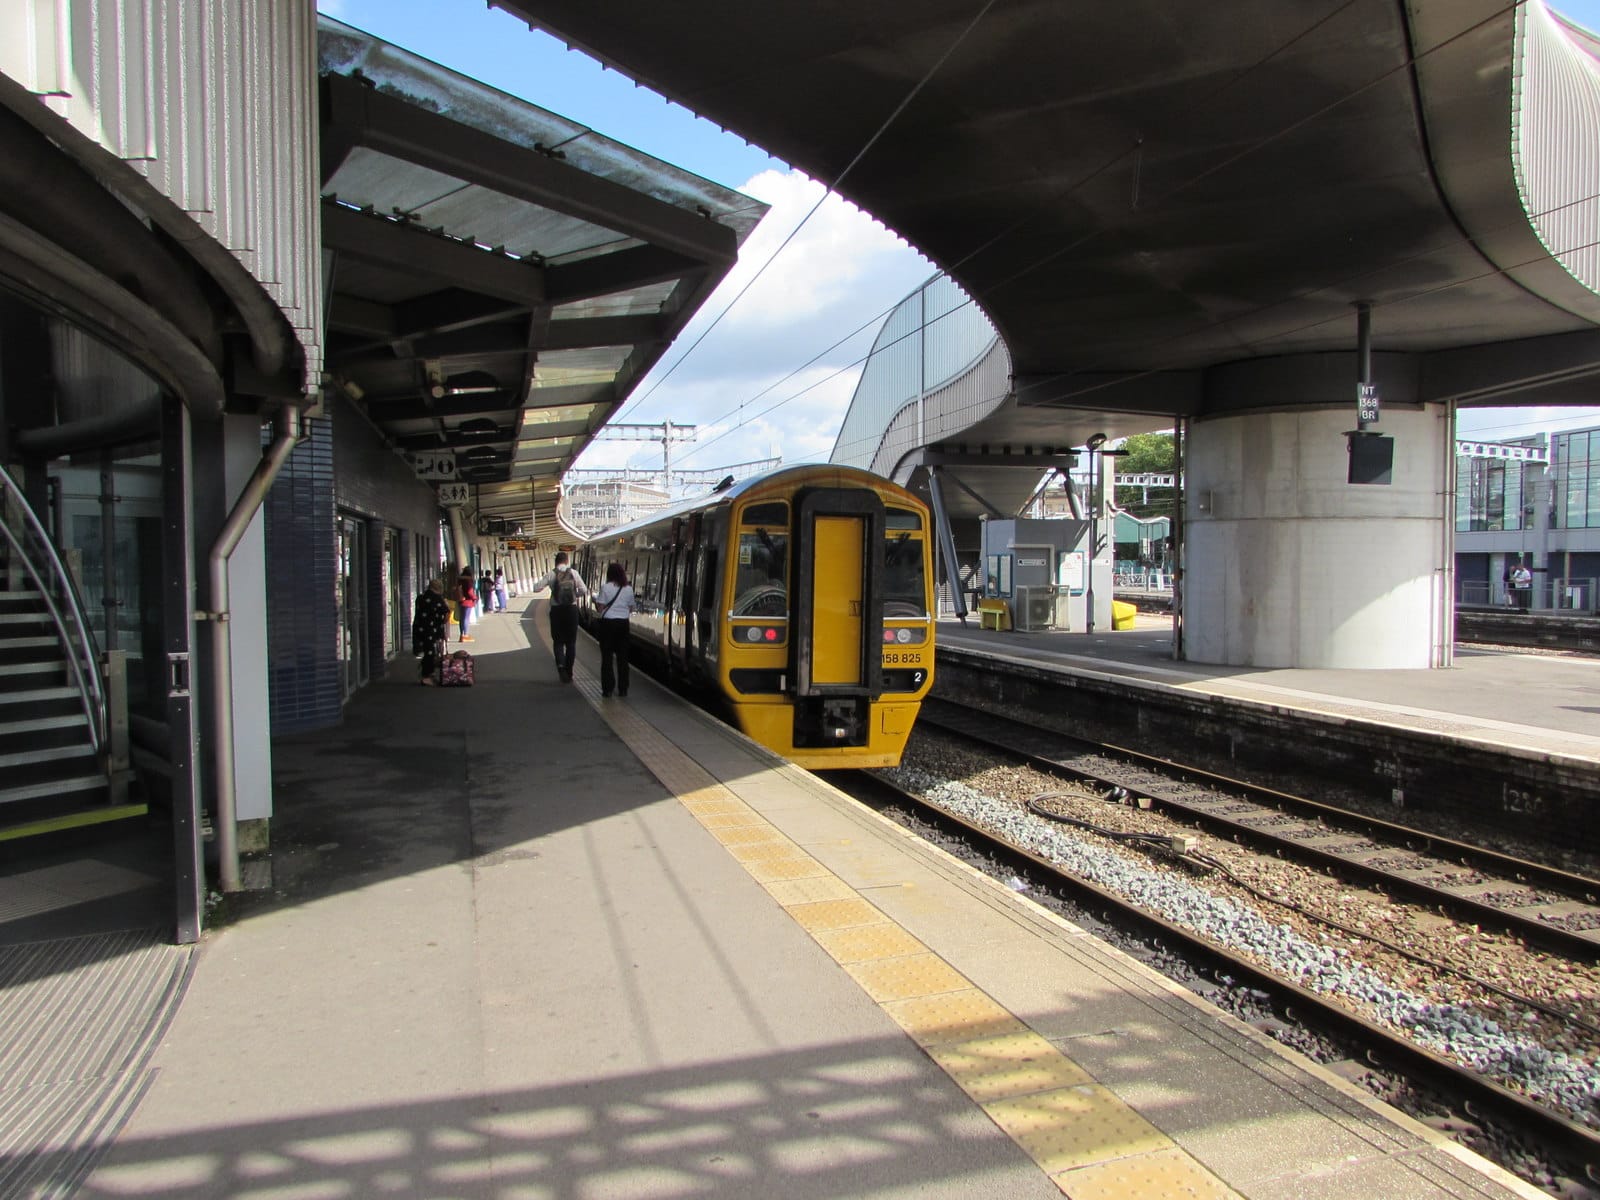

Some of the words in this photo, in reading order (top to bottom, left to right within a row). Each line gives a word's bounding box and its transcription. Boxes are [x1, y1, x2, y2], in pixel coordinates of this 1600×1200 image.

[1361, 386, 1375, 395] NT
[1361, 410, 1375, 419] BR
[882, 653, 899, 663] 158
[901, 653, 921, 663] 825
[914, 671, 922, 682] 2
